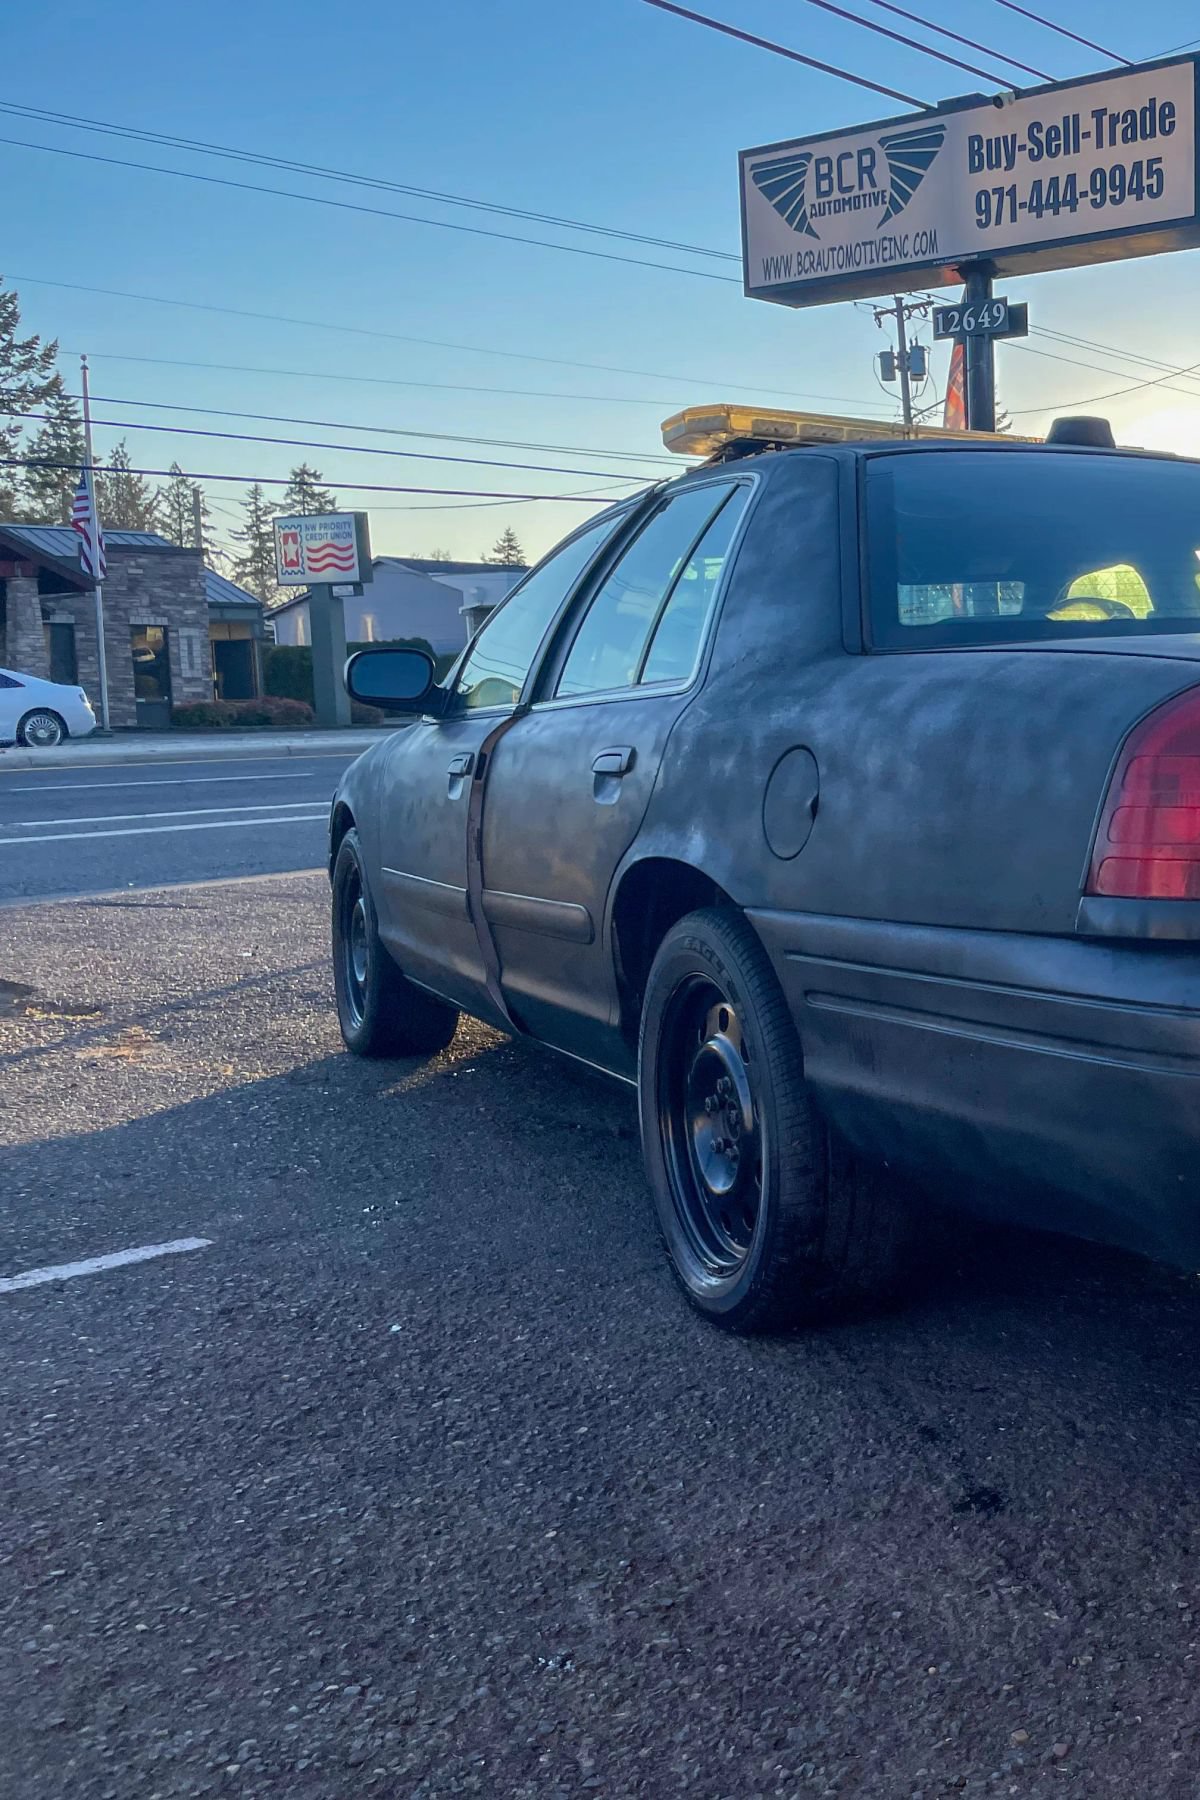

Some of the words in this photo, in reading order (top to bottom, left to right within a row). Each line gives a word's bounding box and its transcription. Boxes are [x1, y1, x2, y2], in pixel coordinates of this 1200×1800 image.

[968, 97, 1176, 174] Buy-Sell-Trade
[814, 147, 877, 199] BCR
[975, 156, 1164, 229] 971-444-9945
[809, 189, 888, 219] AUTOMOTIVE
[762, 229, 939, 281] WWW.BCRAUTOMOTIVEINC.COM
[936, 303, 1005, 335] 12649
[305, 523, 317, 532] NW
[319, 521, 352, 531] PRIORITY
[305, 532, 328, 541] CREDIT
[330, 531, 353, 540] UNION
